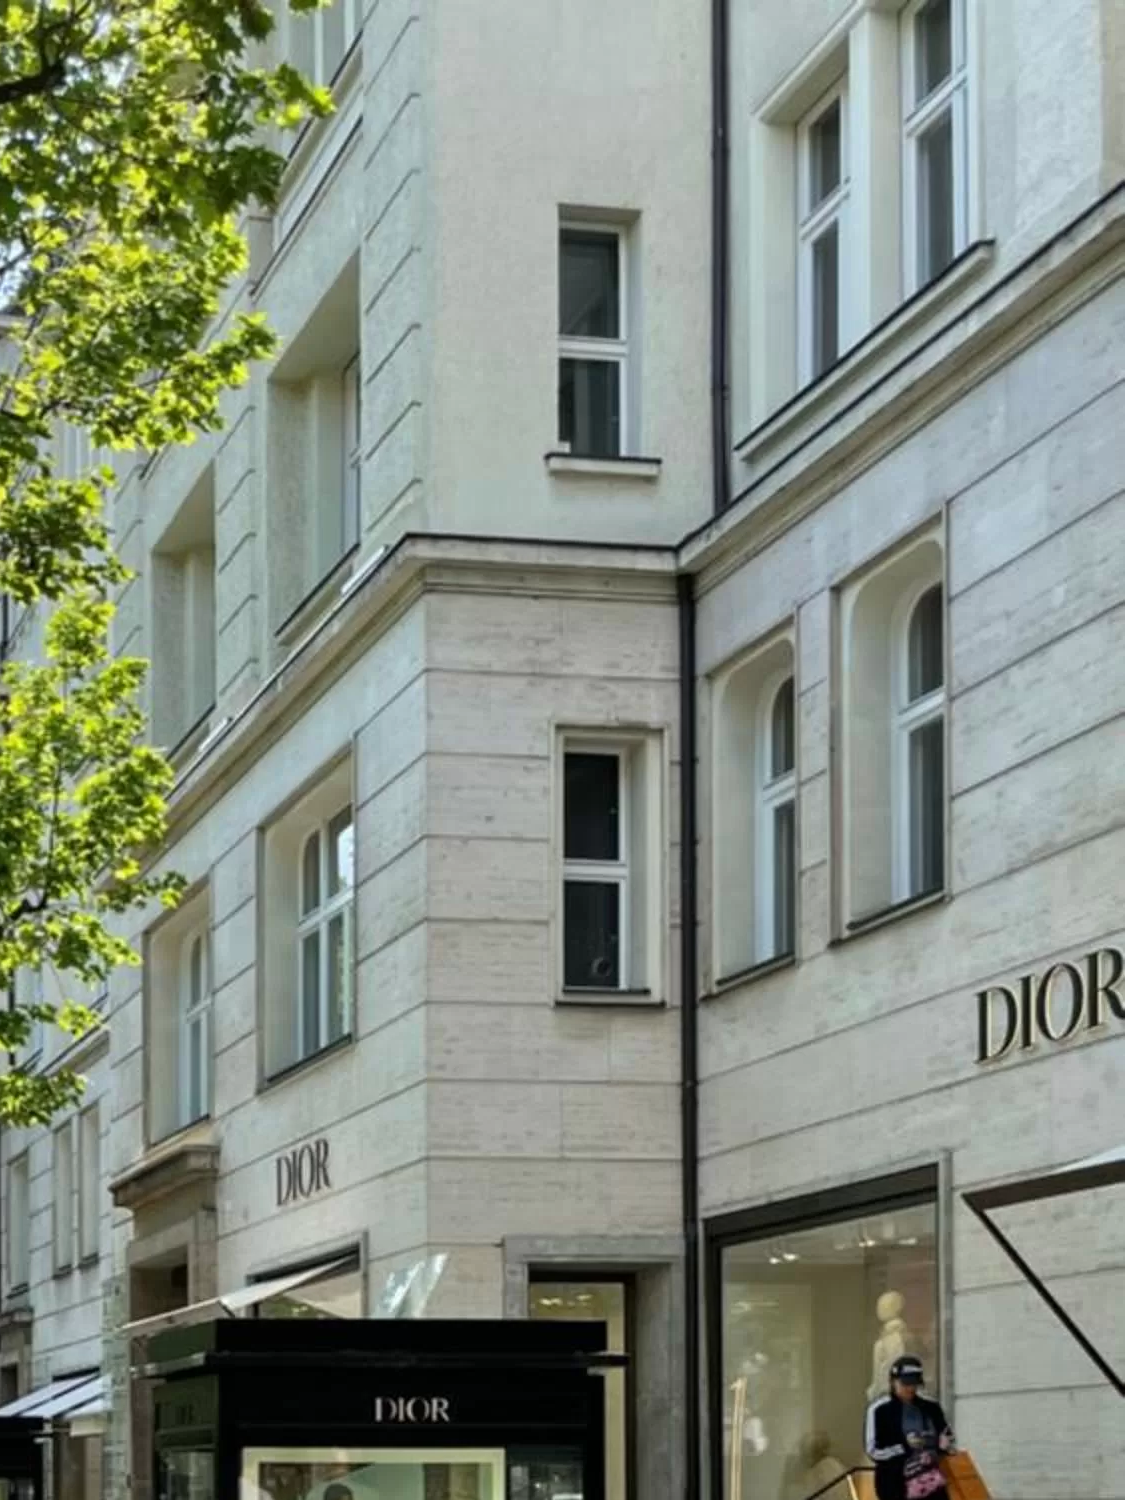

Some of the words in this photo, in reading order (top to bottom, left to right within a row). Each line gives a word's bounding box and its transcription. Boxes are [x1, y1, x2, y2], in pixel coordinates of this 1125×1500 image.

[975, 948, 1125, 1064] DIOR
[276, 1138, 331, 1206] DIOR
[375, 1397, 450, 1422] DIOR
